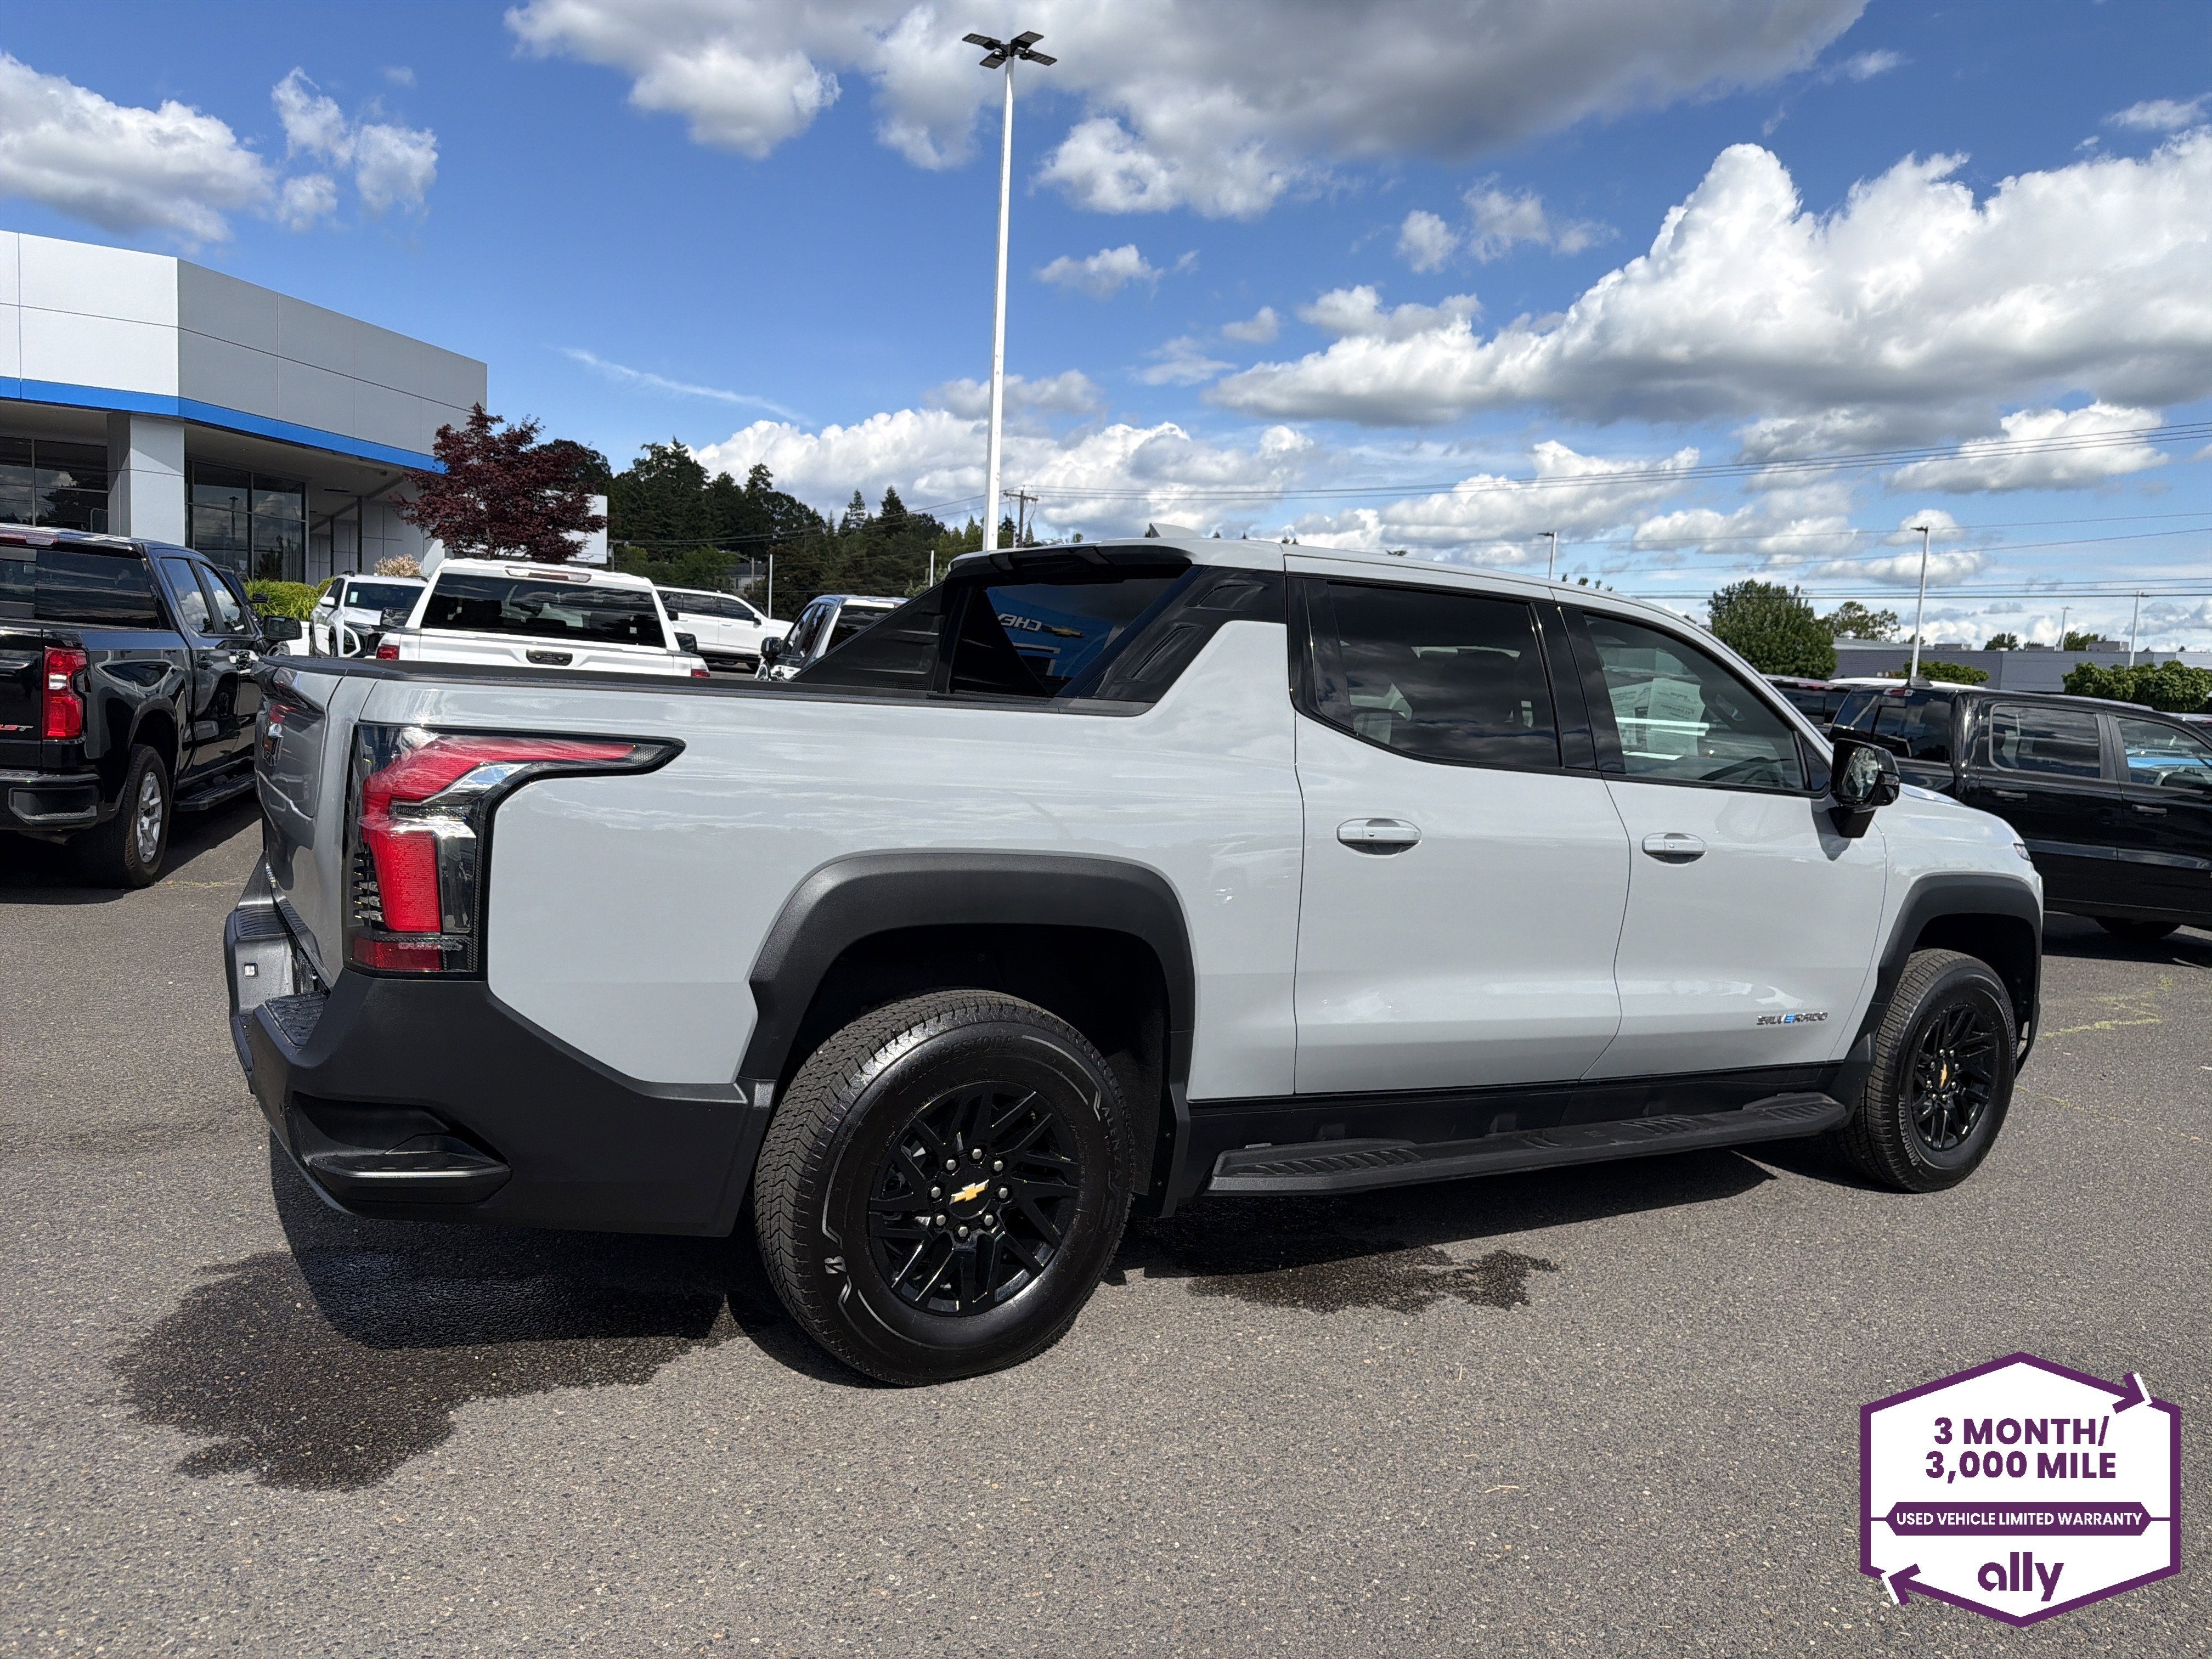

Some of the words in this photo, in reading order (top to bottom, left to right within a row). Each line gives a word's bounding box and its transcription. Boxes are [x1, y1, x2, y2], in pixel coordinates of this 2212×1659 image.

[1756, 1012, 1828, 1025] SILVERADO
[1102, 1107, 1122, 1180] ALENZA
[1898, 1093, 1921, 1166] BRIDGESTONE
